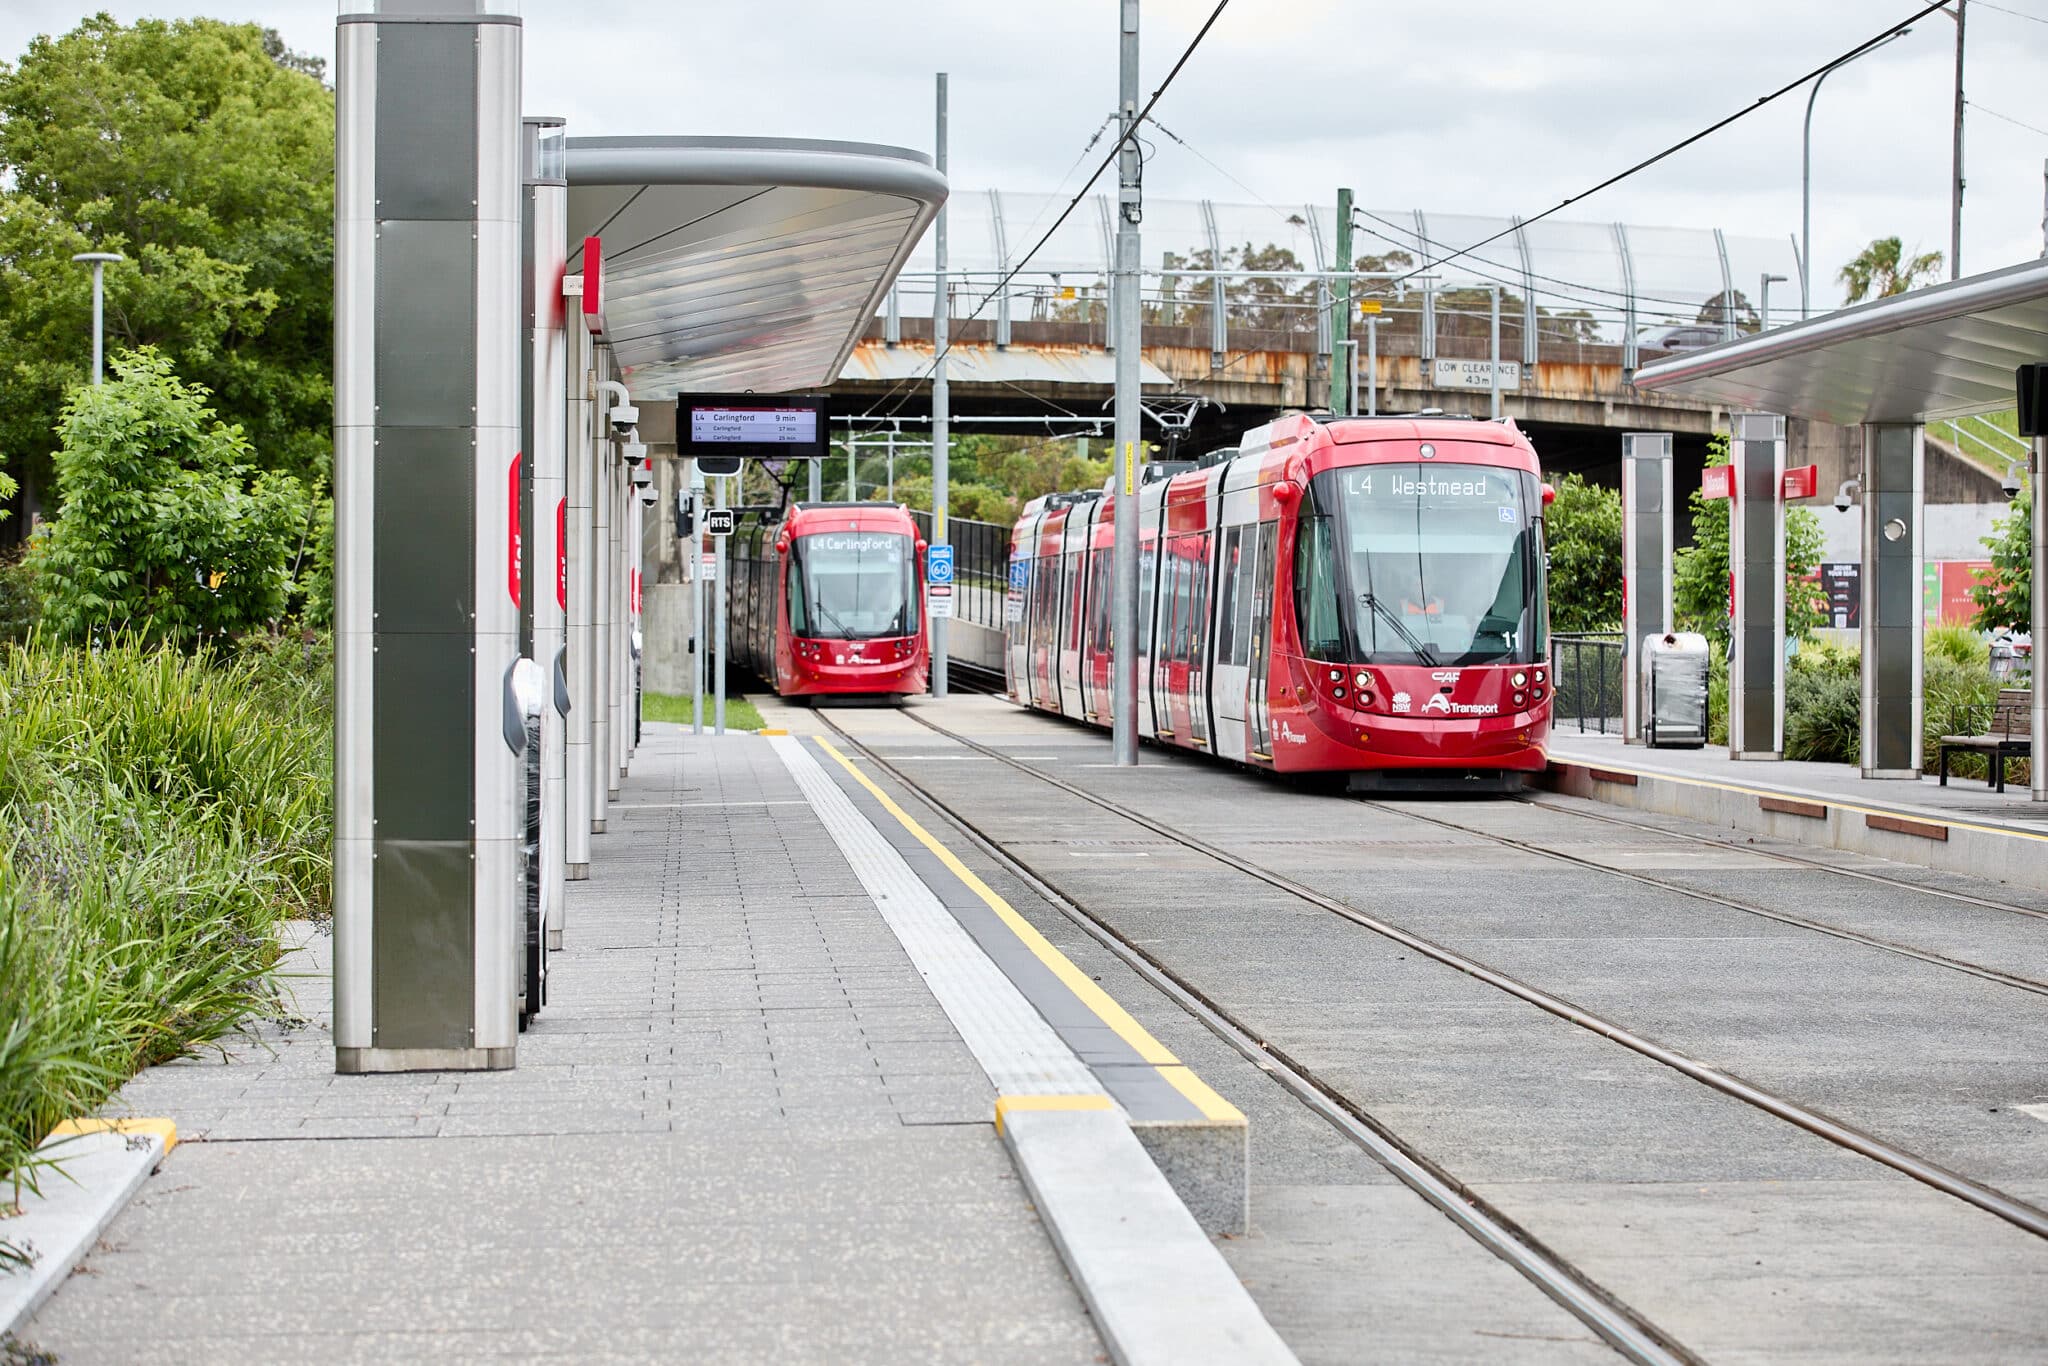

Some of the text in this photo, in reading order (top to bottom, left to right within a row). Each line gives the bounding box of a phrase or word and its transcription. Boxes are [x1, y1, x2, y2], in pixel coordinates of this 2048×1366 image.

[1439, 362, 1516, 375] LOW CLEARNCE
[713, 414, 755, 423] Carlingford
[775, 414, 781, 422] 9
[1349, 474, 1487, 496] L4 Westmead
[711, 517, 731, 528] RTS
[810, 539, 893, 552] L4 Carlingford
[933, 564, 948, 575] 60
[1502, 631, 1520, 649] 11
[1431, 672, 1461, 682] CAF
[1392, 703, 1411, 713] NSW
[1450, 702, 1499, 714] Transport
